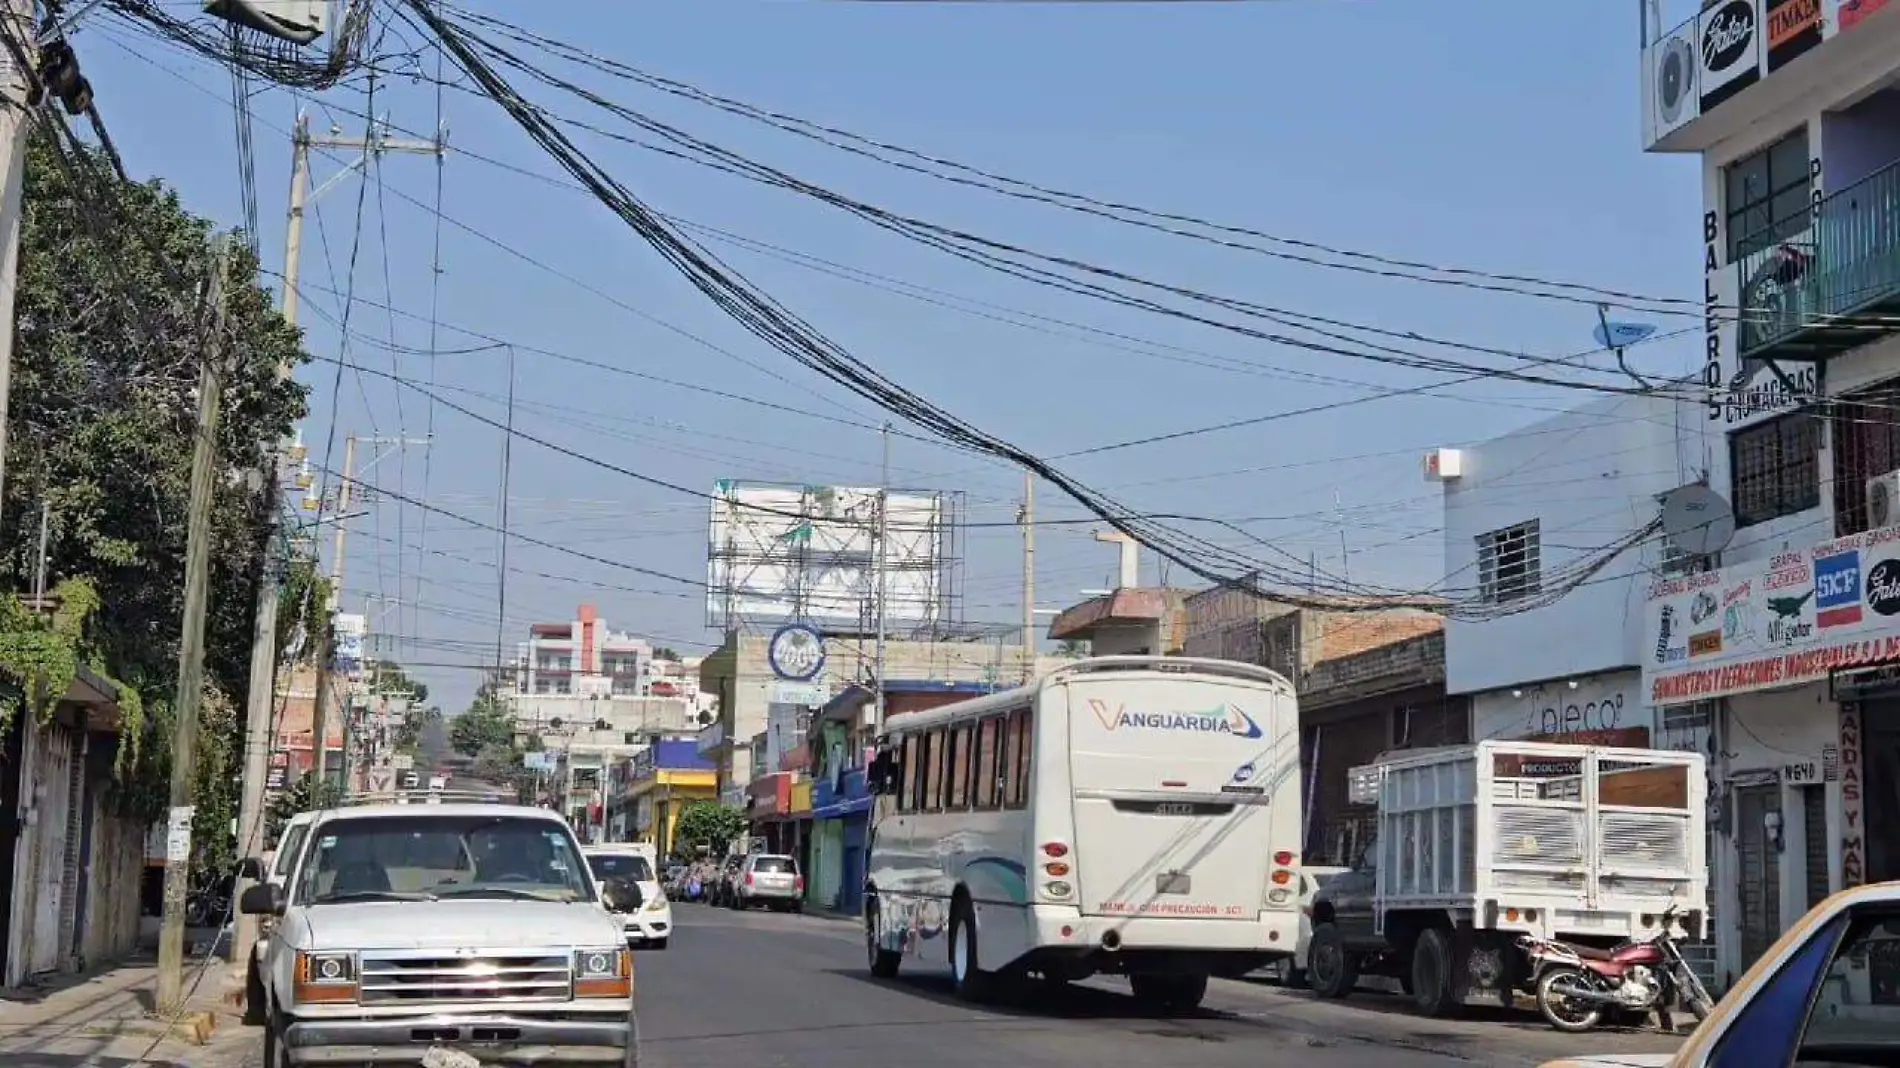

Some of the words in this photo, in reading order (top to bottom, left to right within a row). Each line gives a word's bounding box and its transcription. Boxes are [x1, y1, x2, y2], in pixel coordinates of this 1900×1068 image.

[1704, 211, 1721, 420] BALEROS
[1817, 567, 1857, 598] SKF
[1767, 615, 1813, 646] Alligator
[1088, 699, 1232, 733] VANGUARDIA
[1843, 837, 1862, 885] MAN
